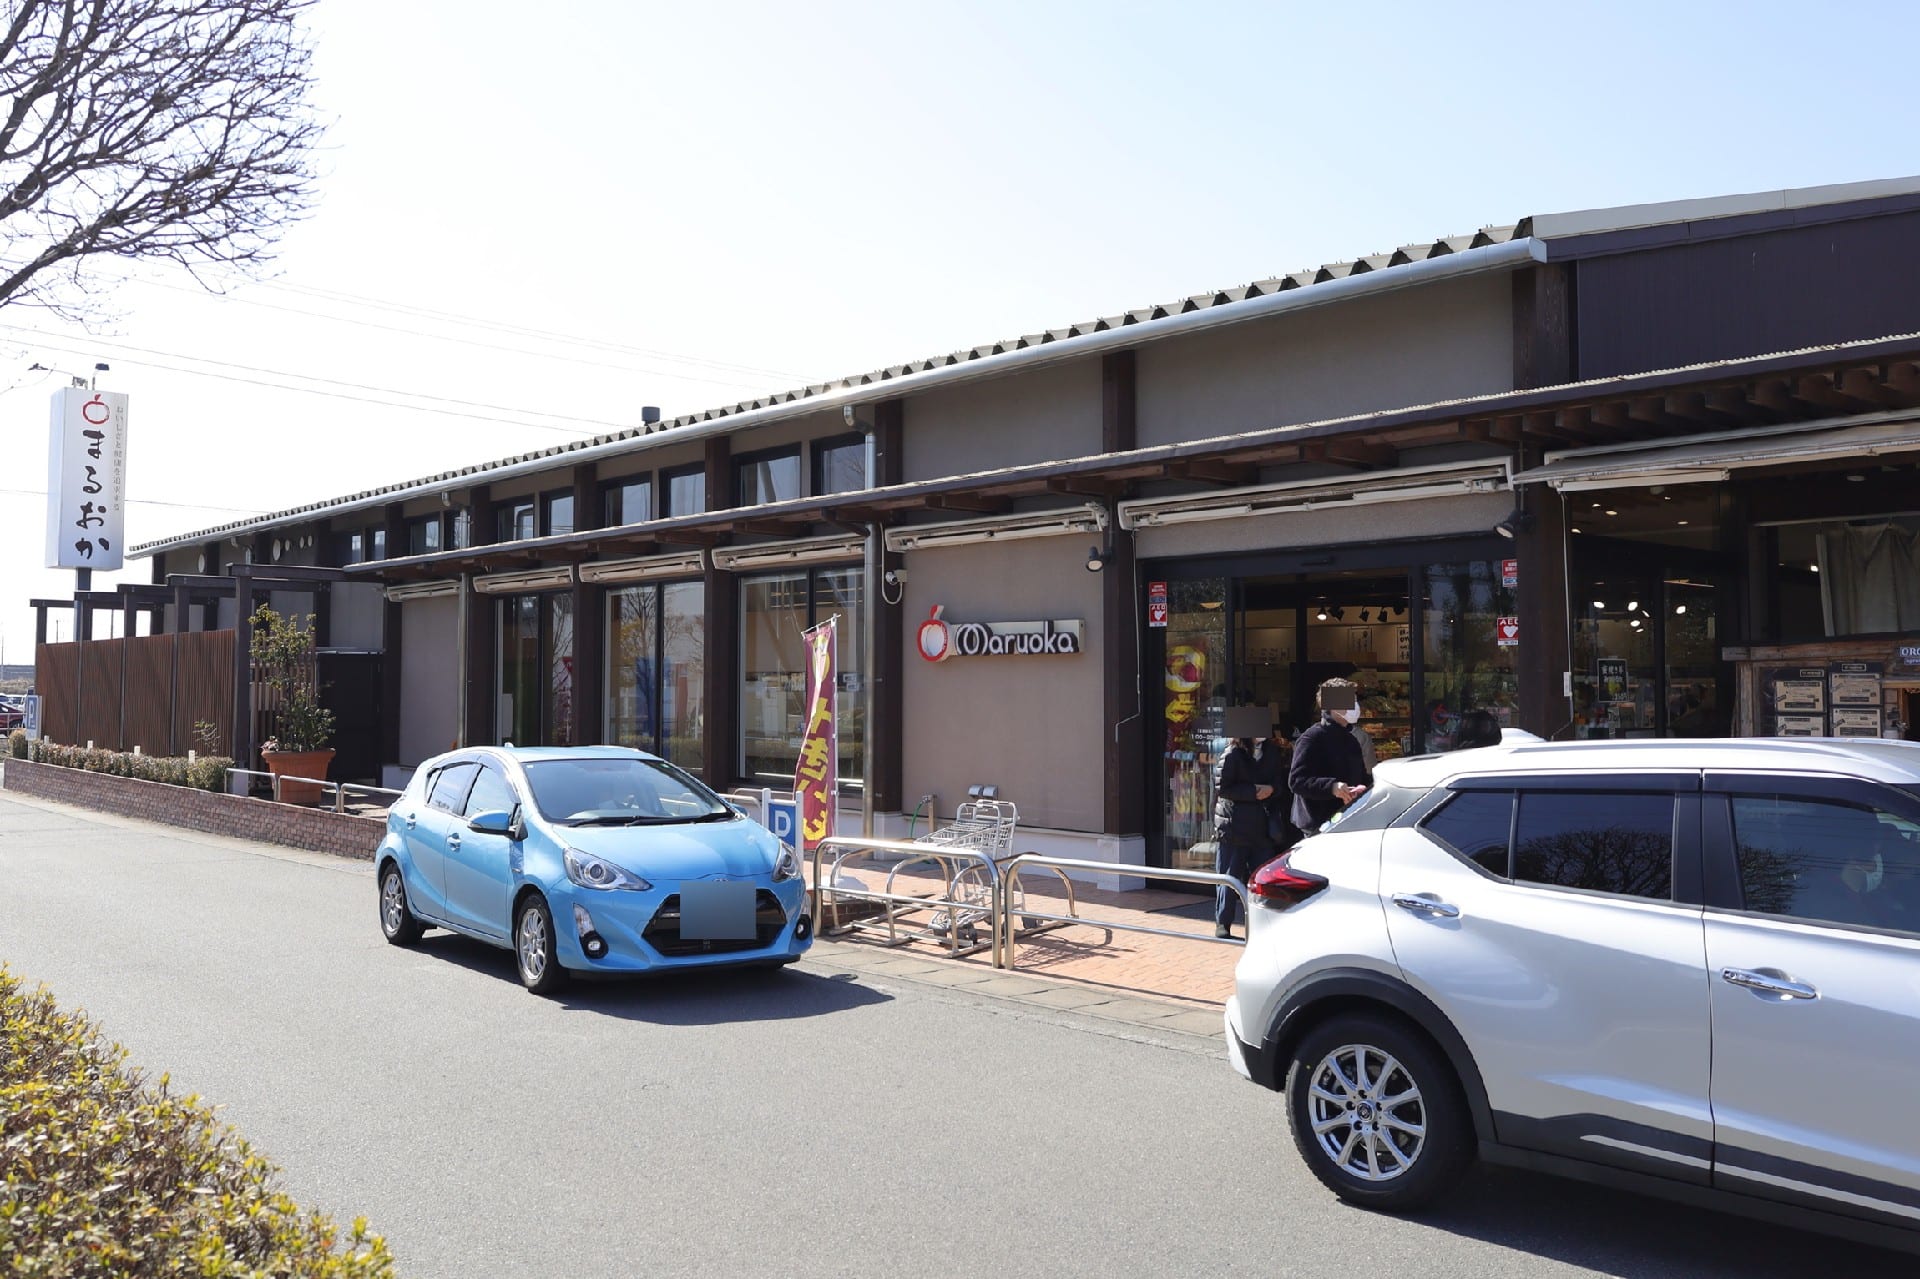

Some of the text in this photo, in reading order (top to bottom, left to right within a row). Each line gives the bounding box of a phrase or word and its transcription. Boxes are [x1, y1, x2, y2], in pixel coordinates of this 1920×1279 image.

[75, 429, 110, 560] まるおか
[955, 620, 1077, 656] Maruoka
